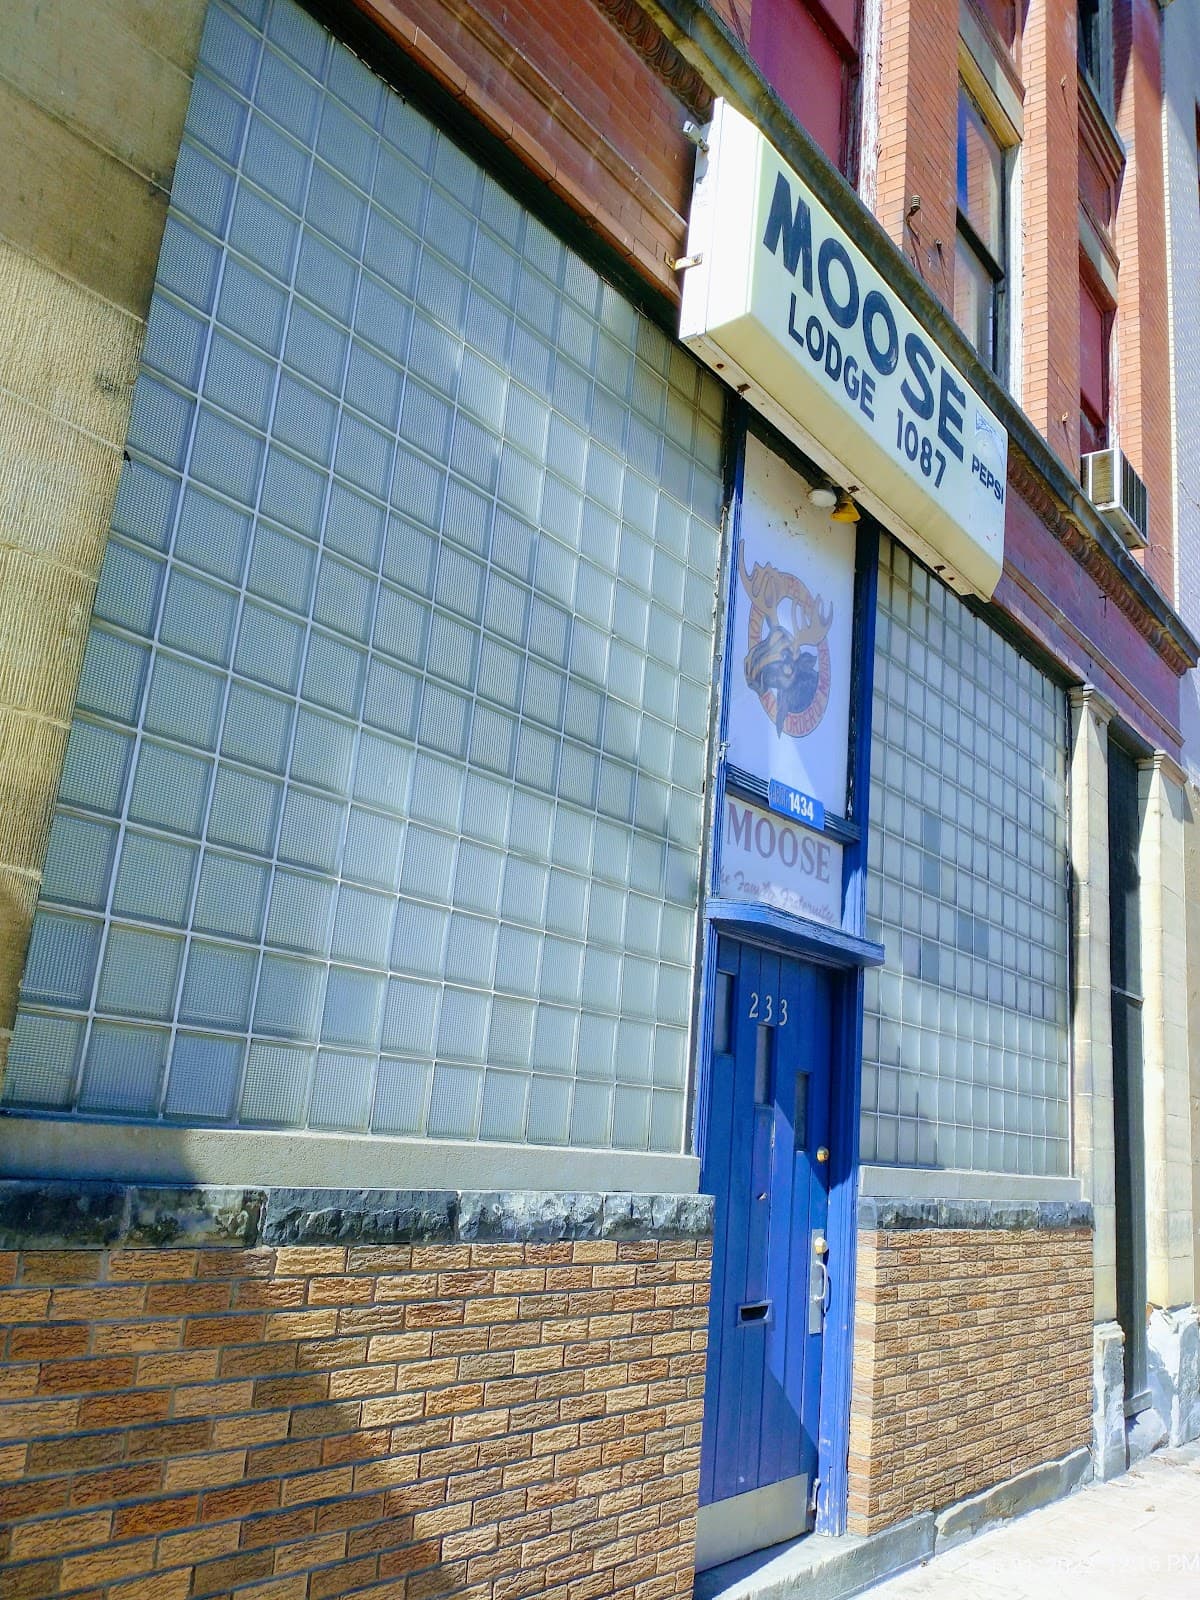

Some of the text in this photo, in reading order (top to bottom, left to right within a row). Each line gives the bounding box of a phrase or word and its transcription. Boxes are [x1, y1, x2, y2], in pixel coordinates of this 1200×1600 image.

[763, 171, 966, 463] MOOSE
[787, 292, 947, 489] LODGE 1087
[970, 455, 1004, 505] PEPSI
[789, 792, 815, 822] 1434
[726, 802, 831, 884] MOOSE
[748, 991, 789, 1026] 233
